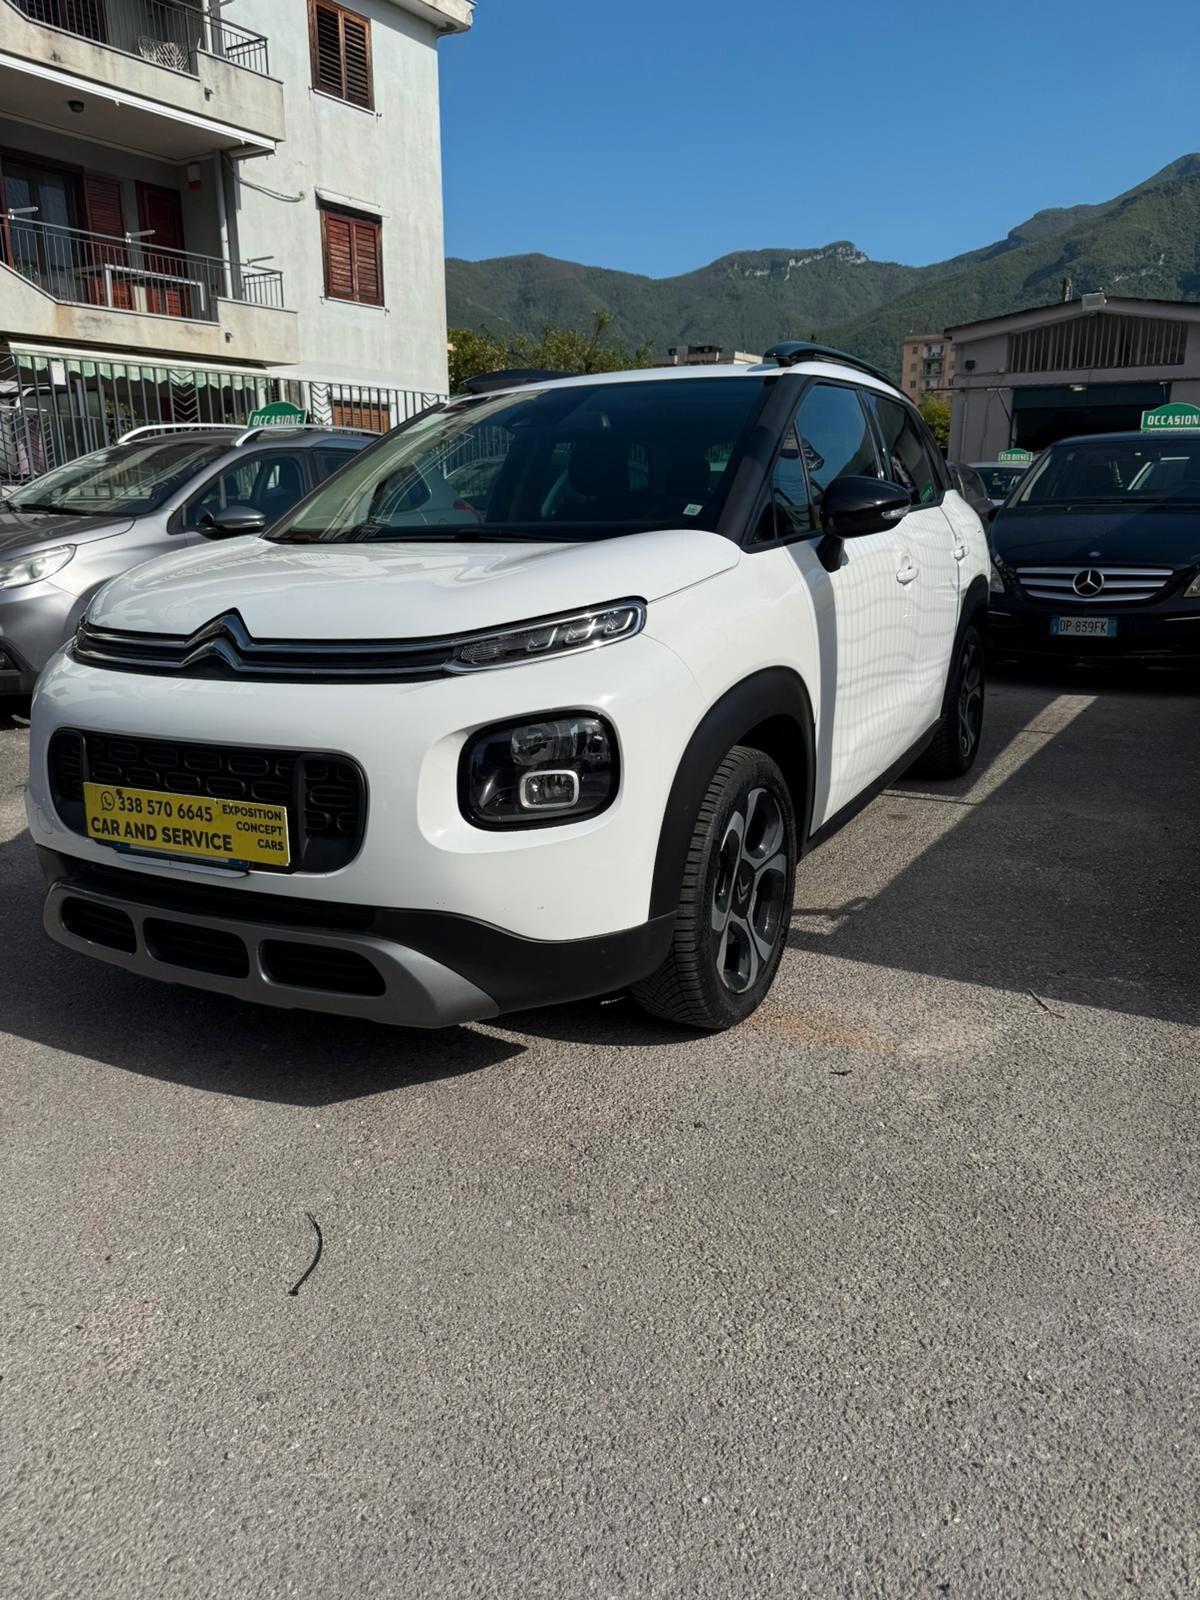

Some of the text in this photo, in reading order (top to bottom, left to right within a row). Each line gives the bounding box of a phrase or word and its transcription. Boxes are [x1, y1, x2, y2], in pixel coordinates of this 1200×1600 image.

[253, 414, 302, 426] OCCASIONE
[1147, 414, 1200, 426] OCCASION
[118, 795, 213, 822] 338 570 6645
[222, 804, 282, 821] EXPOSITION
[91, 816, 233, 852] CAR AND SERVICE
[236, 821, 283, 836] CONCEPT
[257, 838, 284, 851] CARS
